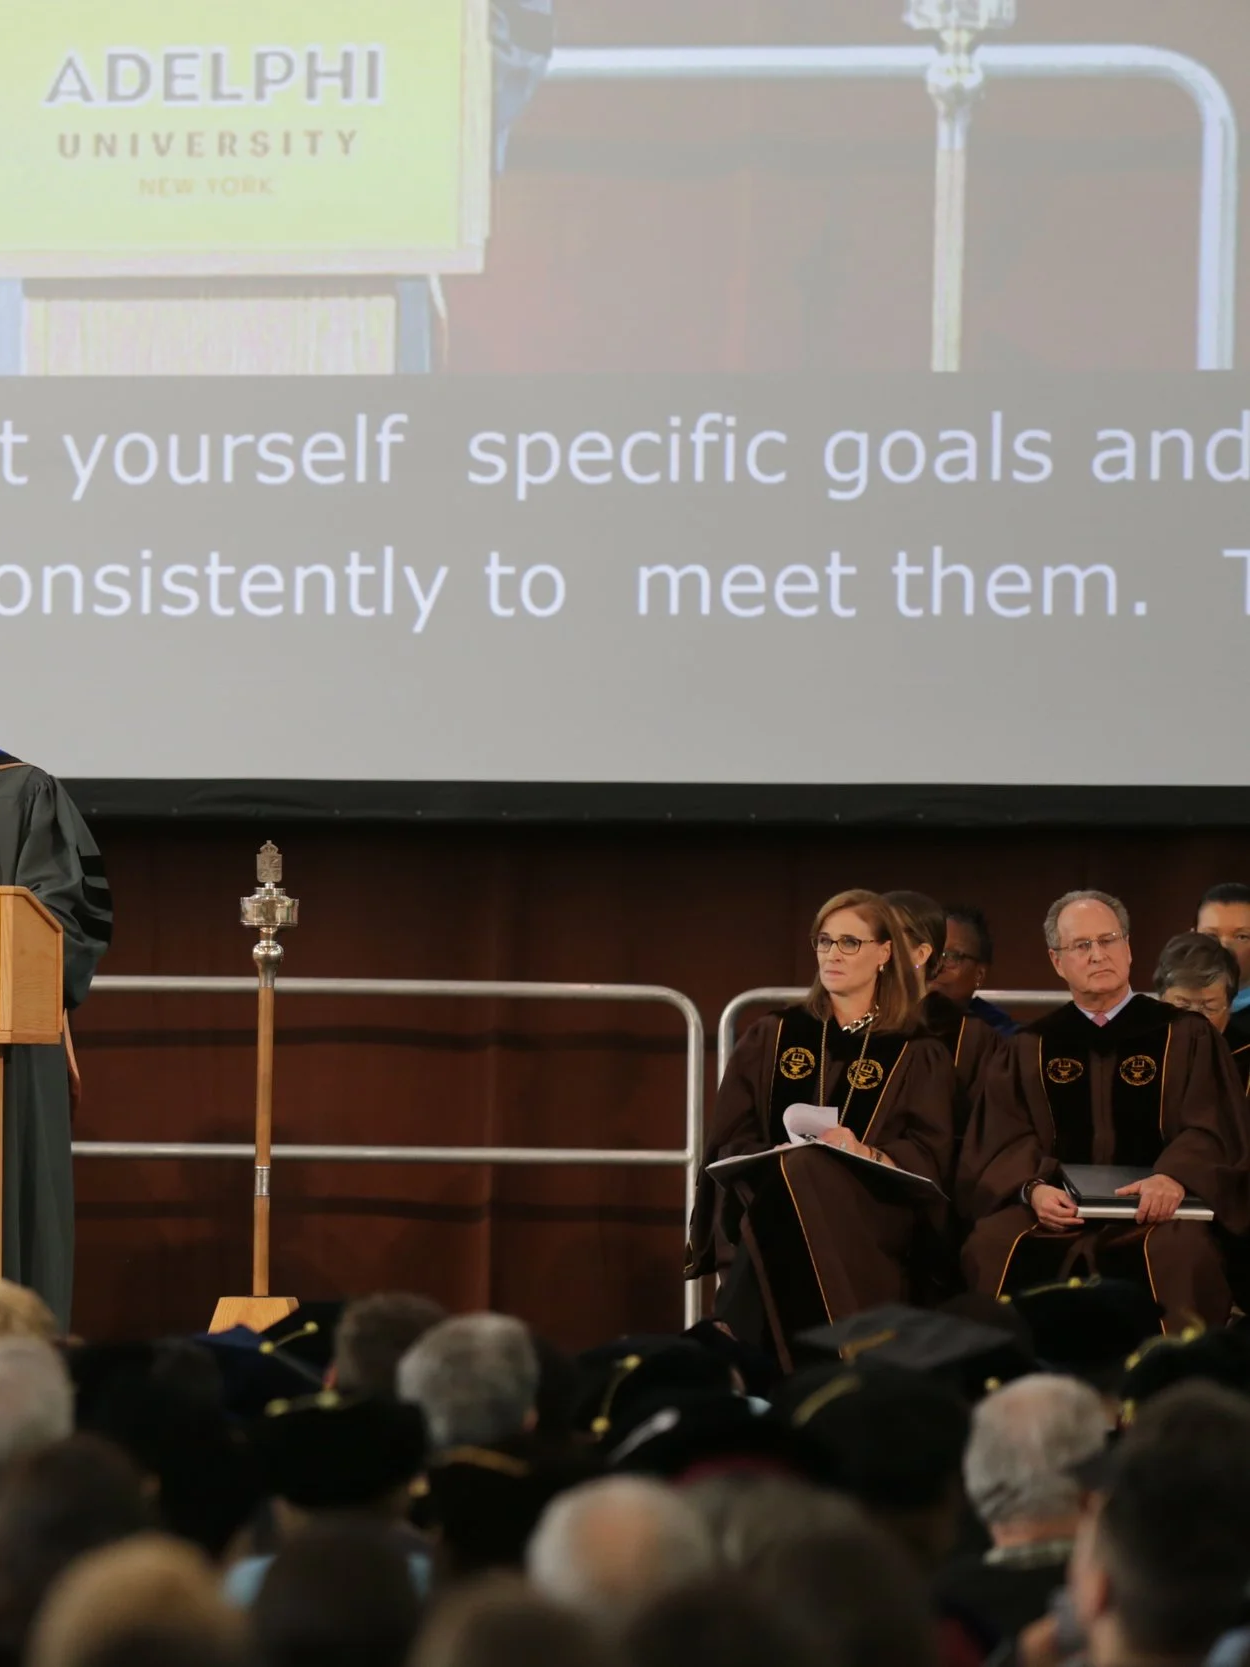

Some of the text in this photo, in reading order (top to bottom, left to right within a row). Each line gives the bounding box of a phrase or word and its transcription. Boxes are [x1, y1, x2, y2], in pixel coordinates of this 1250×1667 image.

[43, 47, 383, 104] ADELPHI
[57, 129, 359, 159] UNIVERSITY
[138, 174, 276, 197] NEW YORK
[63, 414, 410, 502] yourself
[468, 412, 788, 502] specific
[824, 411, 1054, 502] goals
[1092, 410, 1250, 484] and
[485, 552, 567, 619] to
[638, 551, 858, 619] meet
[892, 546, 1148, 619] them.
